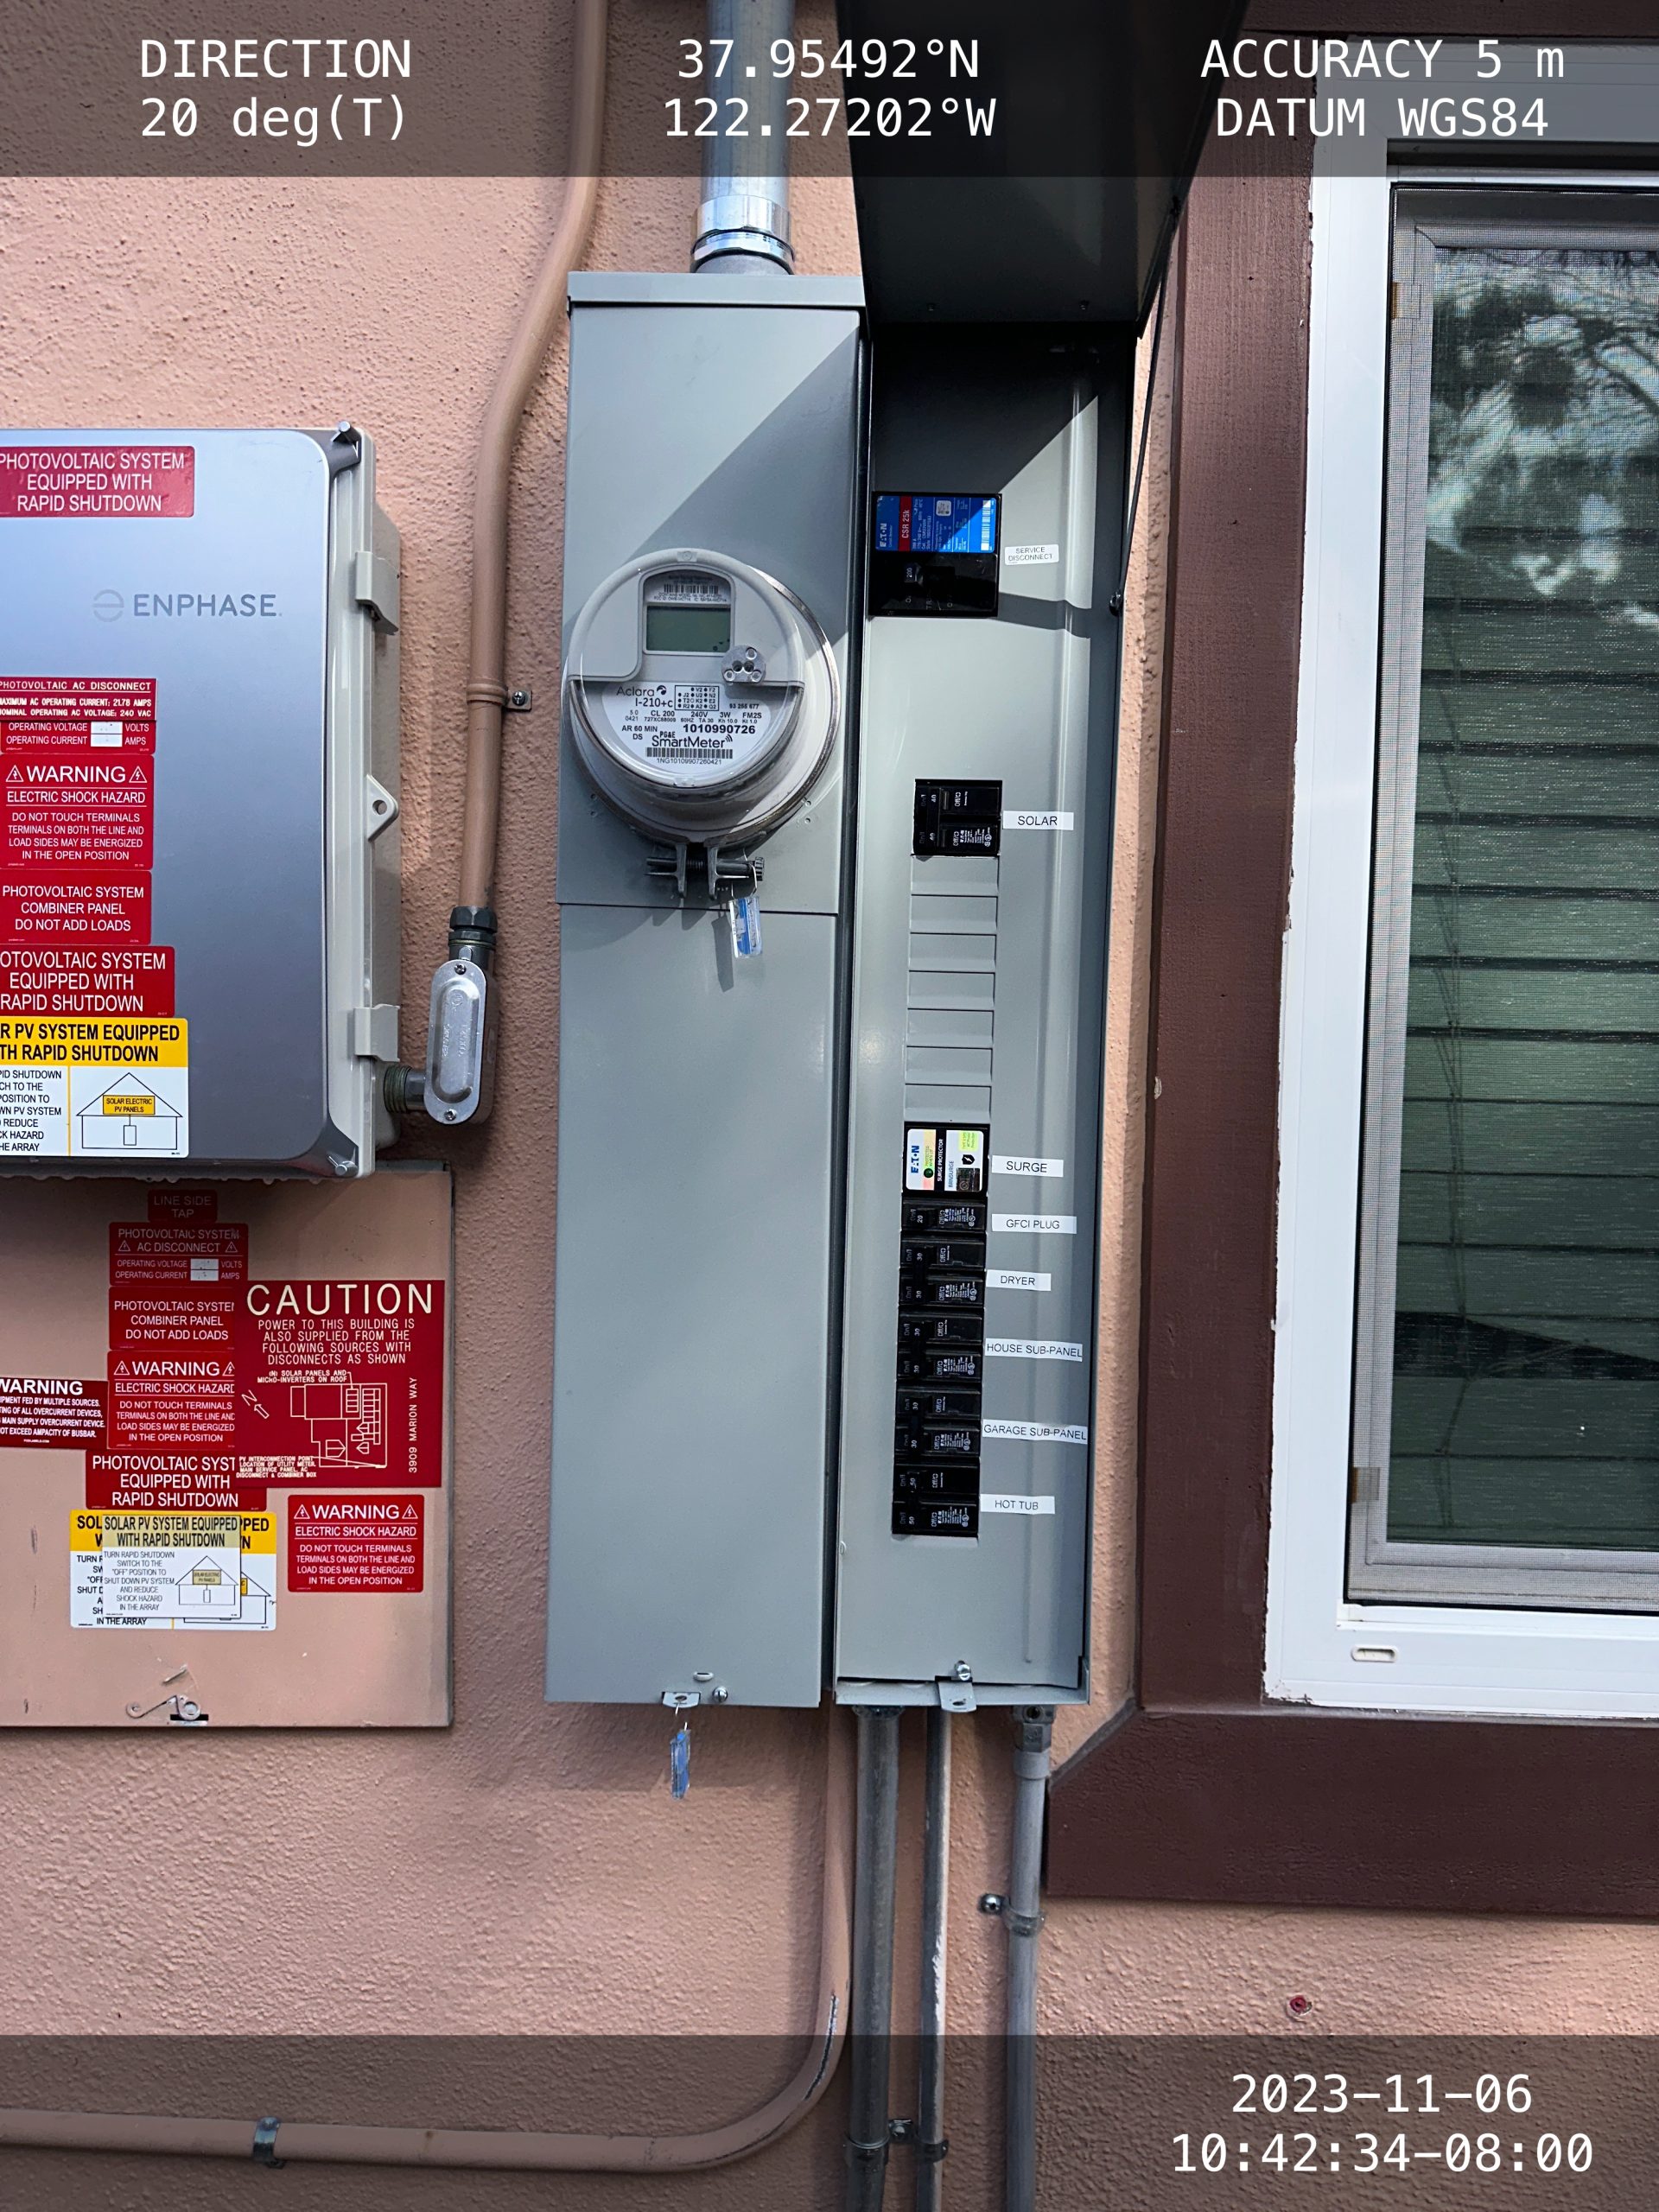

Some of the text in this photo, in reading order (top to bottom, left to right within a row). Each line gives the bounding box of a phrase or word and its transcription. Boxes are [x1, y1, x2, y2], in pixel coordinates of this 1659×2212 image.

[0, 453, 184, 469] PHOTOVOLTAIC SYSTEM
[28, 474, 152, 491] EQUIPPED WITH
[17, 495, 162, 512] RAPID SHUTDOWN
[133, 594, 276, 617] ENPHASE
[91, 682, 151, 690] DISCONNECT
[616, 686, 655, 696] Aclara
[9, 722, 51, 731] OPERATING
[125, 723, 149, 732] VOLTS
[683, 724, 755, 734] 1010990726
[51, 736, 87, 745] CURRENT
[652, 735, 725, 748] SmartMeter
[27, 766, 125, 783] WARNING
[7, 791, 145, 803] ELECTRIC SHOCK HAZARD
[51, 813, 83, 822] TOUCH
[86, 813, 139, 822] TERMINALS
[1018, 816, 1058, 825] SOLAR
[8, 825, 144, 835] TERMINALS ON BOTH THE LINE AND
[10, 838, 143, 848] LOAD SIDES MAY BE ENERGIZED
[22, 850, 129, 860] IN THE OPEN POSITION
[3, 886, 143, 898] PHOTOVOLTAIC SYSTEM
[21, 902, 125, 914] COMBINER PANEL
[15, 919, 130, 931] DO NOT ADD LOADS
[0, 951, 166, 969] OTOVOLTAIC SYSTEM
[10, 972, 134, 989] EQUIPPED WITH
[1, 995, 143, 1011] RAPID SHUTDOWN
[15, 1024, 180, 1041] PV SYSTEM EQUIPPED
[22, 1045, 158, 1061] RAPID SHUTDOWN
[1007, 1161, 1047, 1173] SURGE
[1007, 1219, 1060, 1229] GFCI PLUG
[1001, 1275, 1035, 1286] DRYER
[247, 1283, 432, 1316] CAUTION
[258, 1319, 415, 1330] POWER TO THIS BUILDING IS
[264, 1330, 410, 1341] ALSO SUPPLIED FROM THE
[263, 1342, 411, 1353] FOLLOWING SOURCES WITH
[987, 1344, 1082, 1357] HOUSE SUB-PANEL
[268, 1353, 405, 1365] DISCONNECTS AS SHOWN
[132, 1362, 220, 1376] WARNING
[0, 1379, 83, 1395] WARNING
[409, 1377, 417, 1472] 3909 MARION WAY
[984, 1425, 1087, 1440] GARAGE SUB-PANEL
[92, 1455, 235, 1471] PHOTOVOLTAIC SYST
[120, 1473, 230, 1489] EQUIPPED WITH
[112, 1492, 238, 1507] RAPID SHUTDOWN
[995, 1500, 1038, 1510] HOT TUB
[313, 1505, 399, 1520] WARNING
[105, 1516, 237, 1531] SOLAR PV SYSTEM EQUIPPED
[296, 1527, 416, 1536] ELECTRIC SHOCK HAZARD
[118, 1533, 225, 1547] WITH RAPID SHUTDOWN
